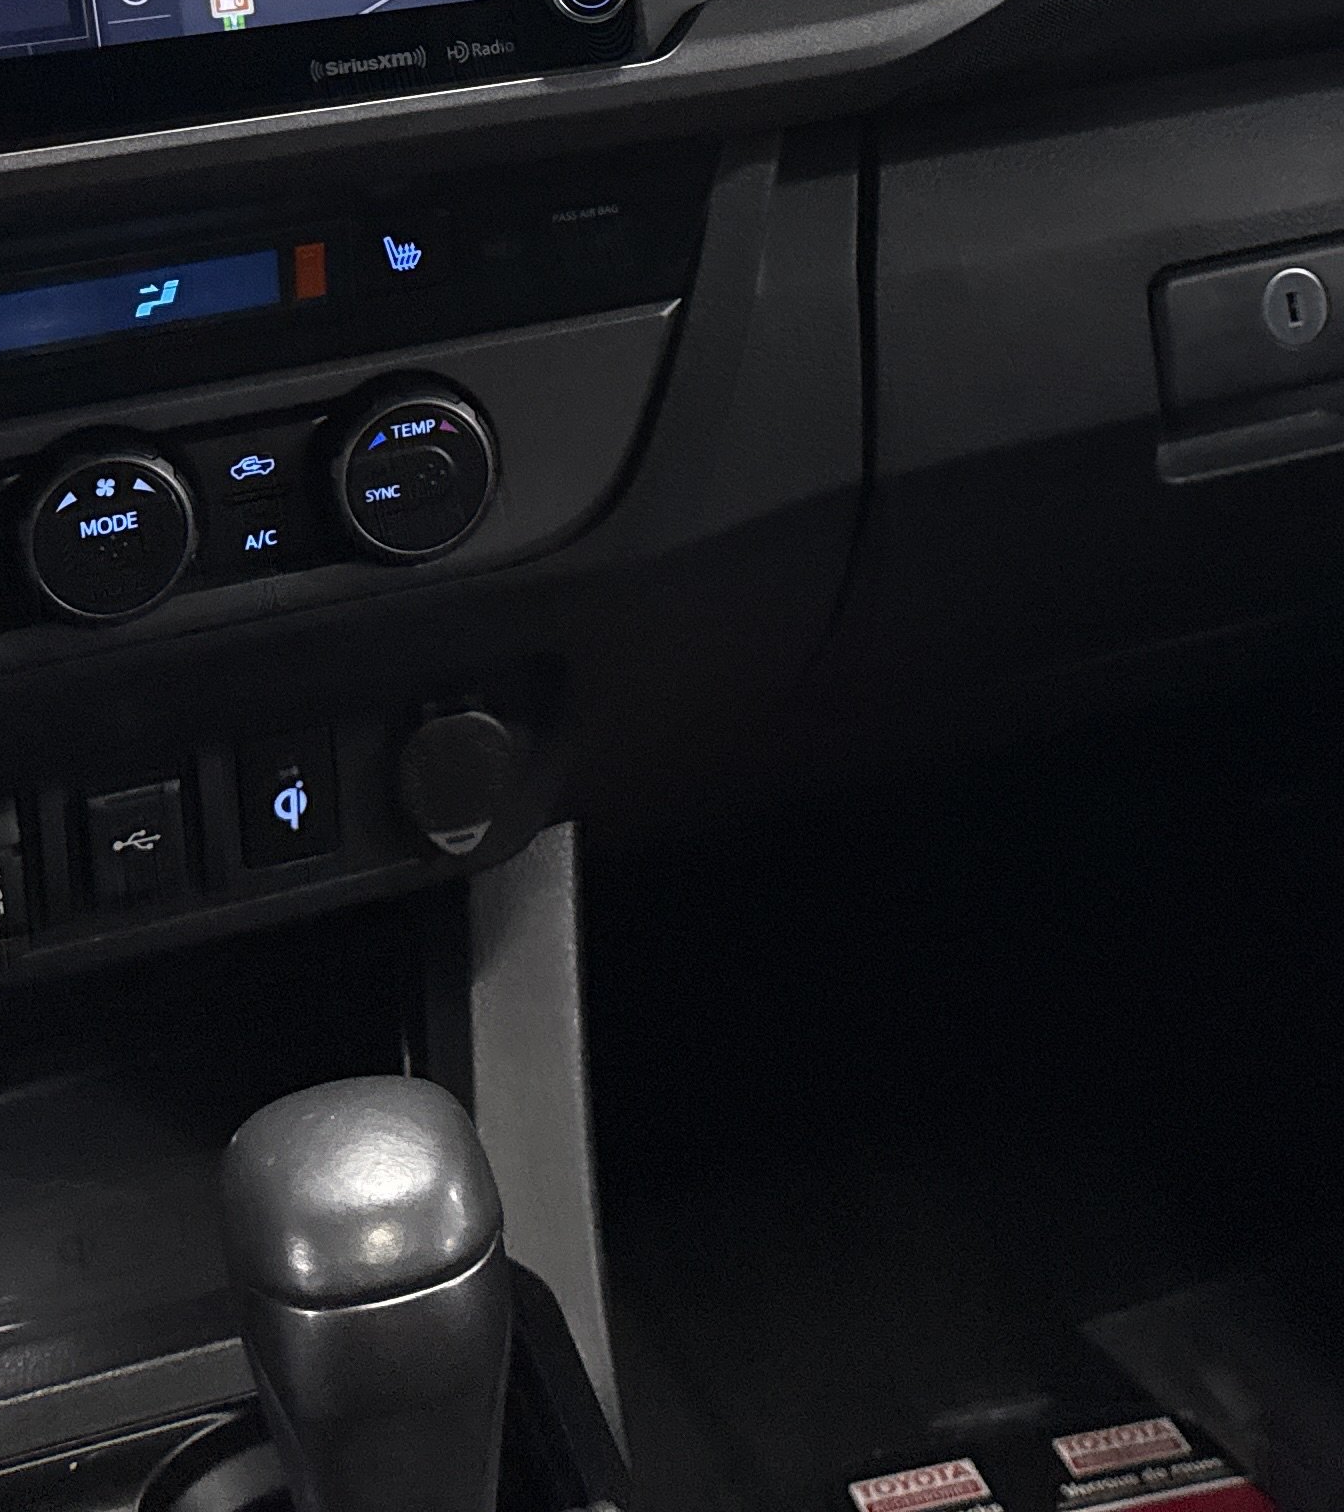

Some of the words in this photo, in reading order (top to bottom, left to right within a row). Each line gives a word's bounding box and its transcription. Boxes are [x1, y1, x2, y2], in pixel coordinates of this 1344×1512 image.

[472, 40, 513, 56] Radio
[552, 211, 577, 223] PASS
[580, 208, 595, 217] AIR
[598, 205, 618, 215] BAG
[391, 419, 435, 438] TEMP
[366, 485, 400, 502] SYNC
[80, 511, 138, 538] MODE
[245, 530, 277, 550] A/C
[860, 1462, 972, 1497] TOYOTA
